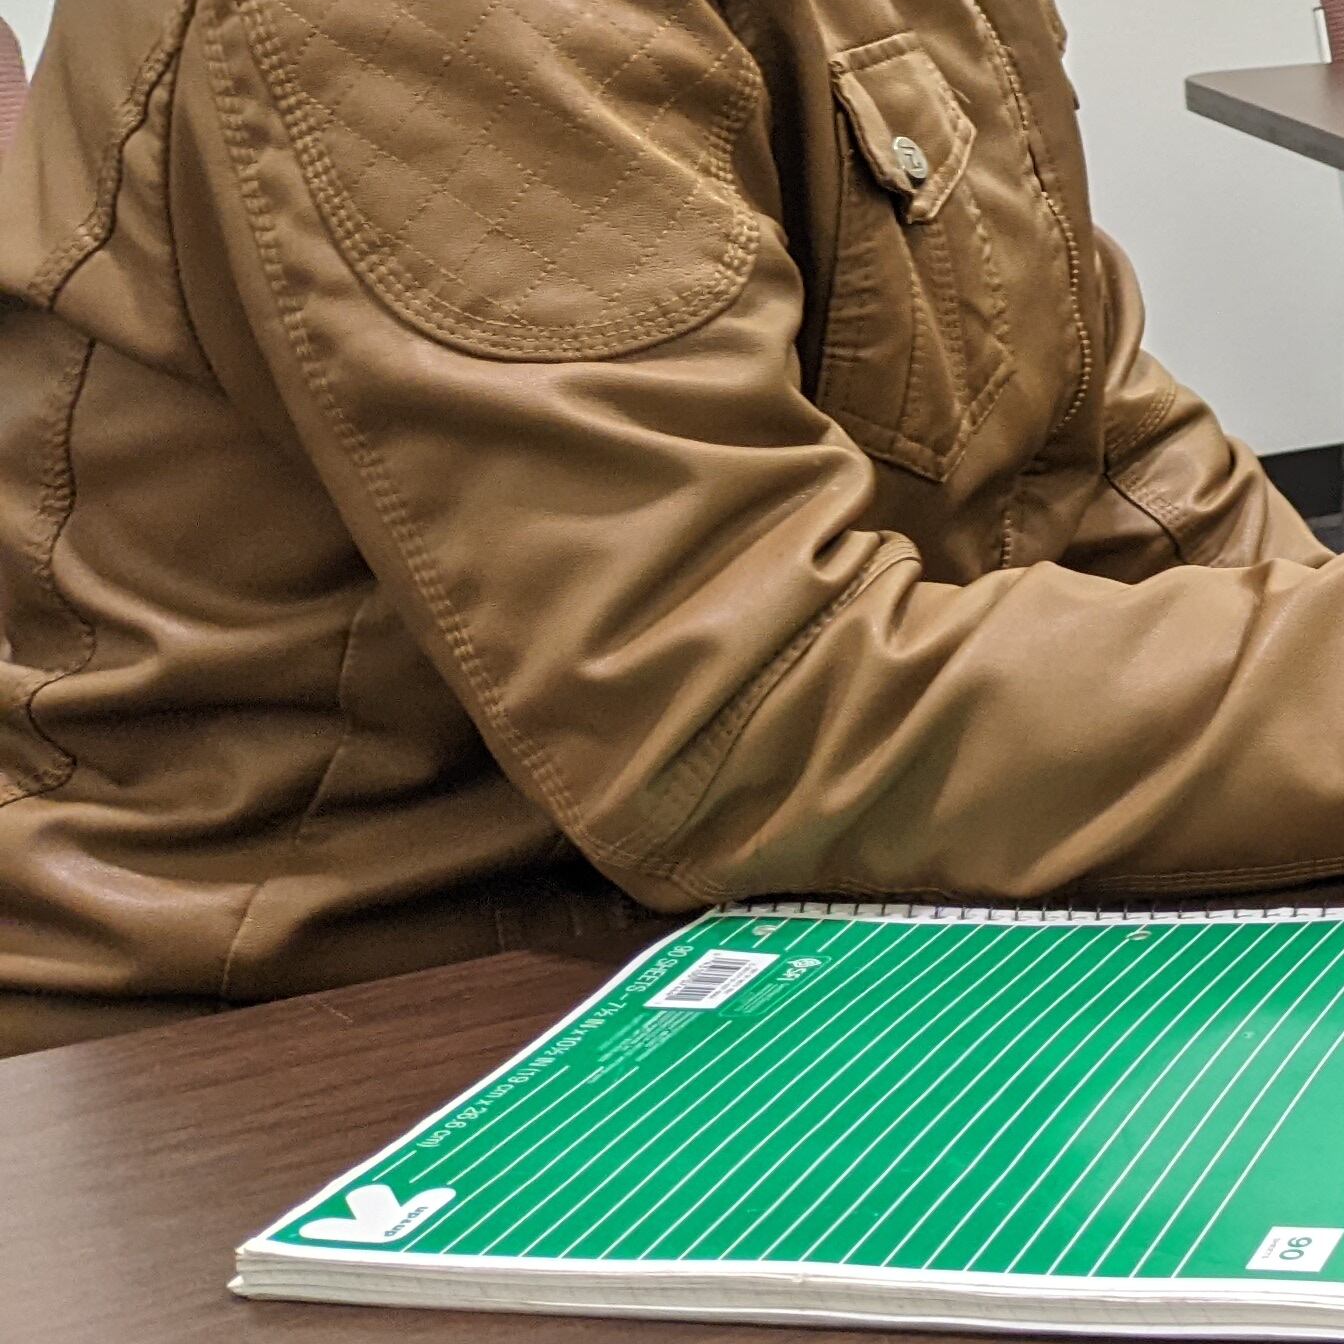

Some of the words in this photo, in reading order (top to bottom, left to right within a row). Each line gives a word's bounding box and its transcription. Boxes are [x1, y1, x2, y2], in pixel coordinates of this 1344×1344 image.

[666, 945, 695, 958] 90
[625, 958, 679, 993] SHEETS
[485, 1084, 515, 1098] cm
[416, 1129, 452, 1148] cm)
[1278, 1236, 1313, 1261] 90
